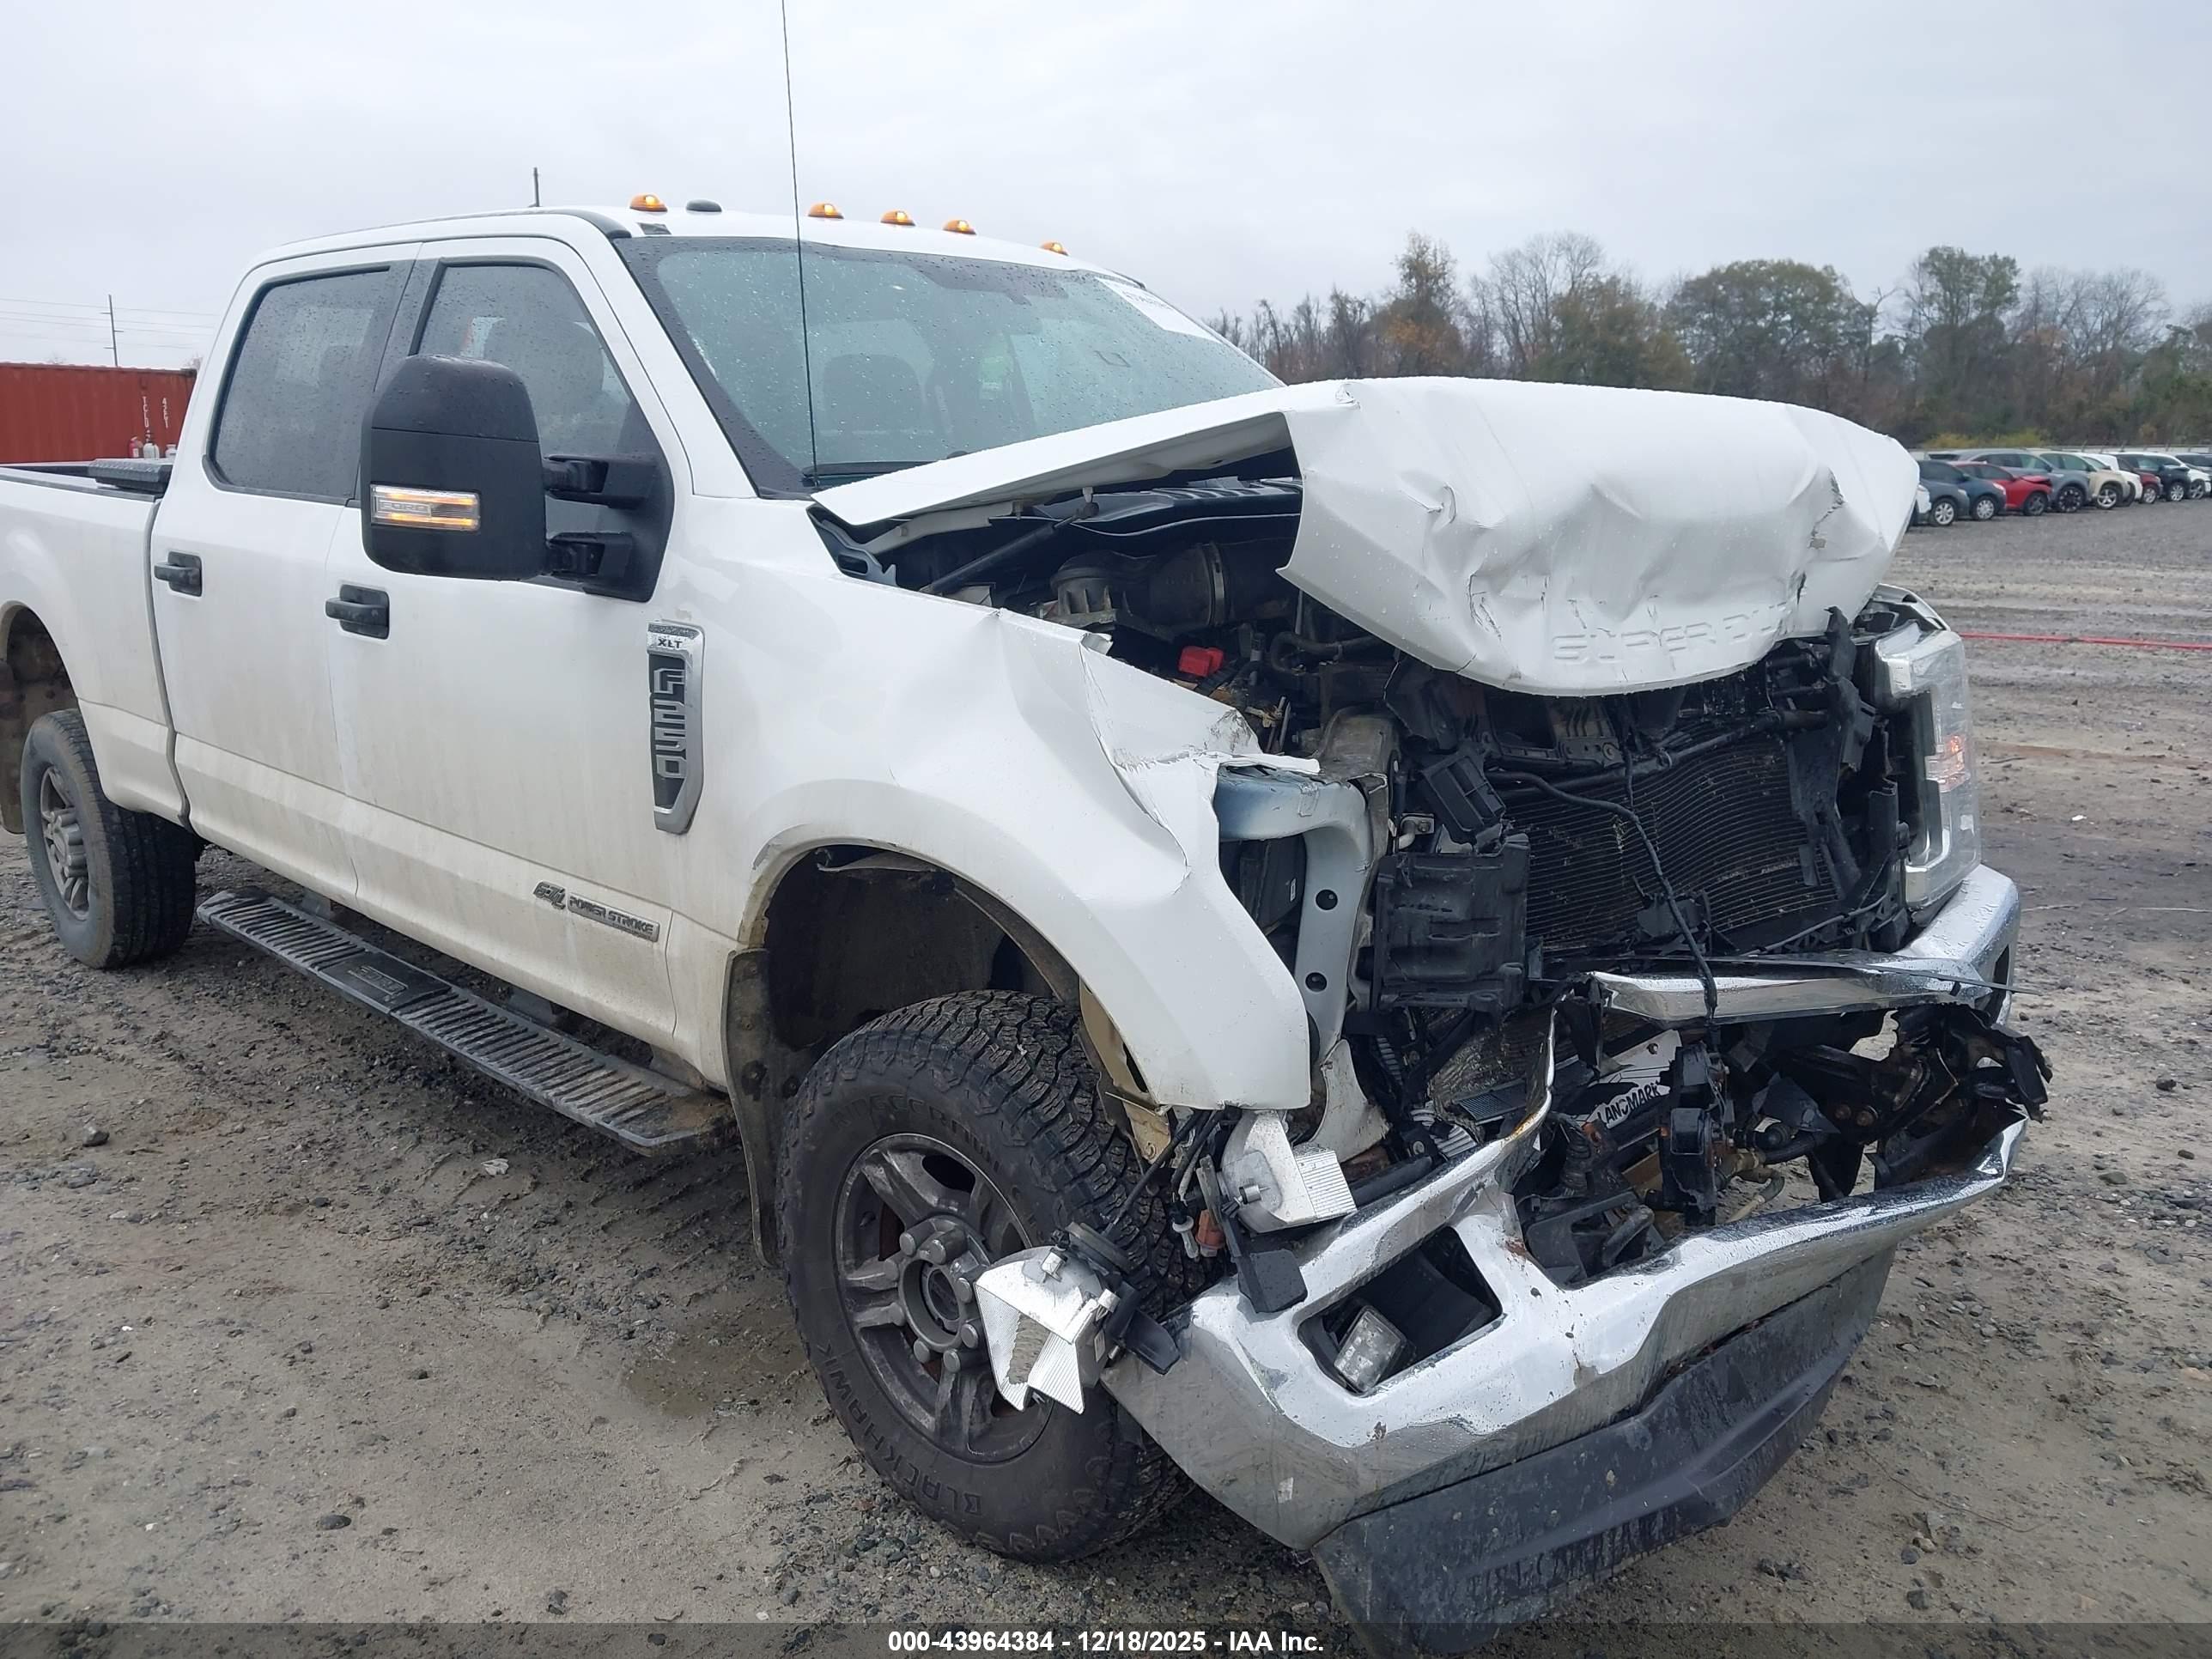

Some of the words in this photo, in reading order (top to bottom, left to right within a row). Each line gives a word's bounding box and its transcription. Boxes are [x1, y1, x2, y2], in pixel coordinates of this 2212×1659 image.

[658, 638, 683, 649] XLT
[569, 896, 606, 919] POWER
[608, 910, 653, 935] STROKE
